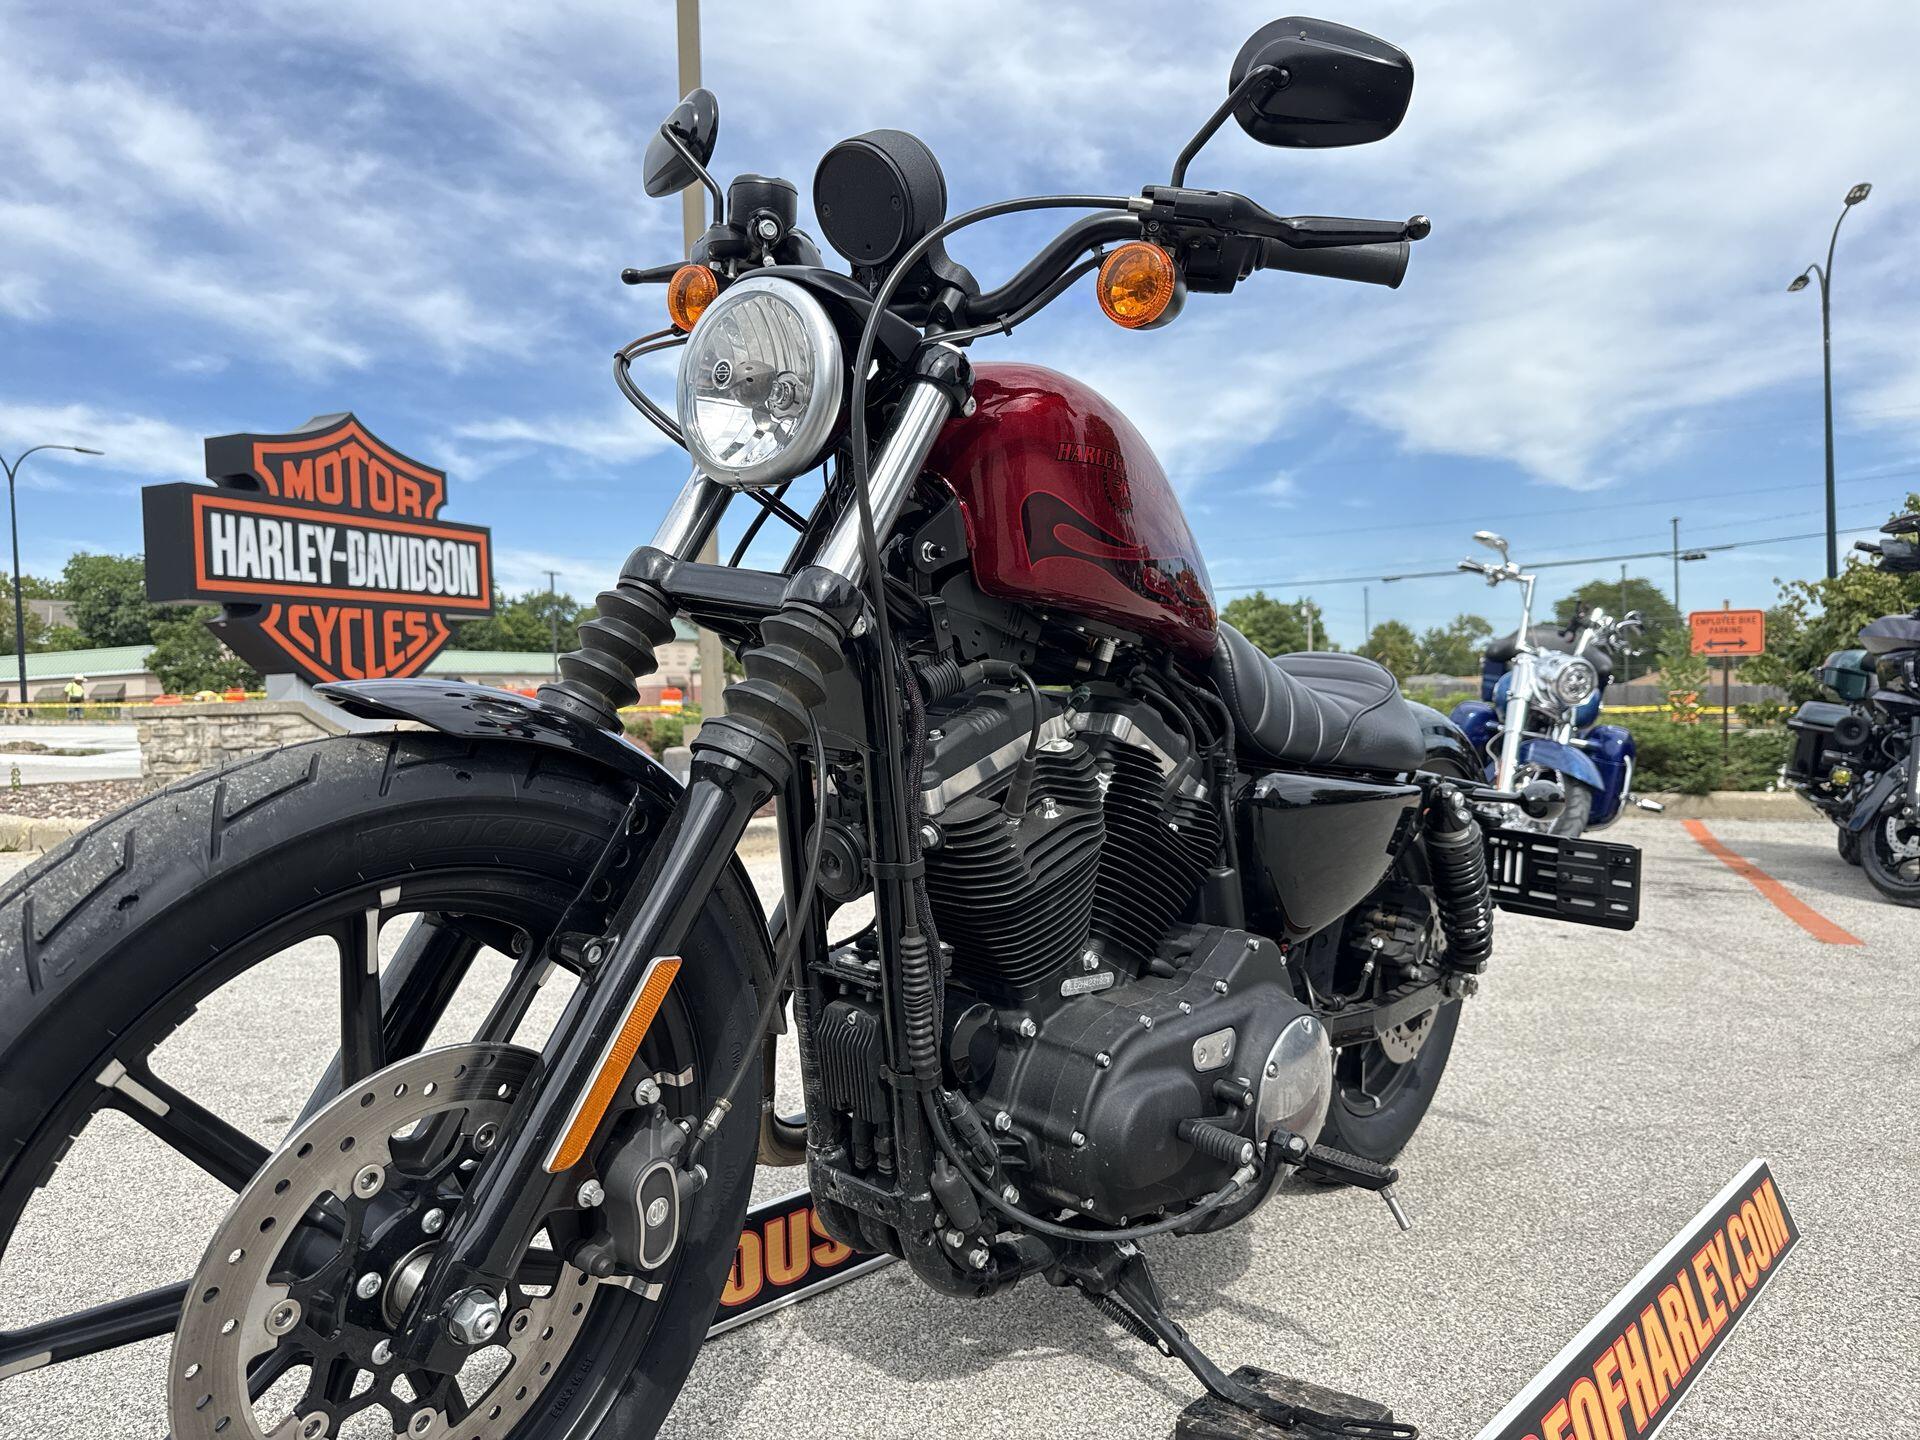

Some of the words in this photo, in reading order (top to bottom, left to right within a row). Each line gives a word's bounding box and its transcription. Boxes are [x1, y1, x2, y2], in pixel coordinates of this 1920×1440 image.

[283, 440, 422, 519] MOTOR
[210, 512, 478, 597] HARLEY-DAVIDSON
[288, 606, 430, 681] CYCLES
[1696, 615, 1735, 626] EMPLOYEE
[1739, 616, 1757, 625] BIKE
[1709, 626, 1743, 634] PARKING
[1521, 1177, 1791, 1440] OFHARLEY.COM
